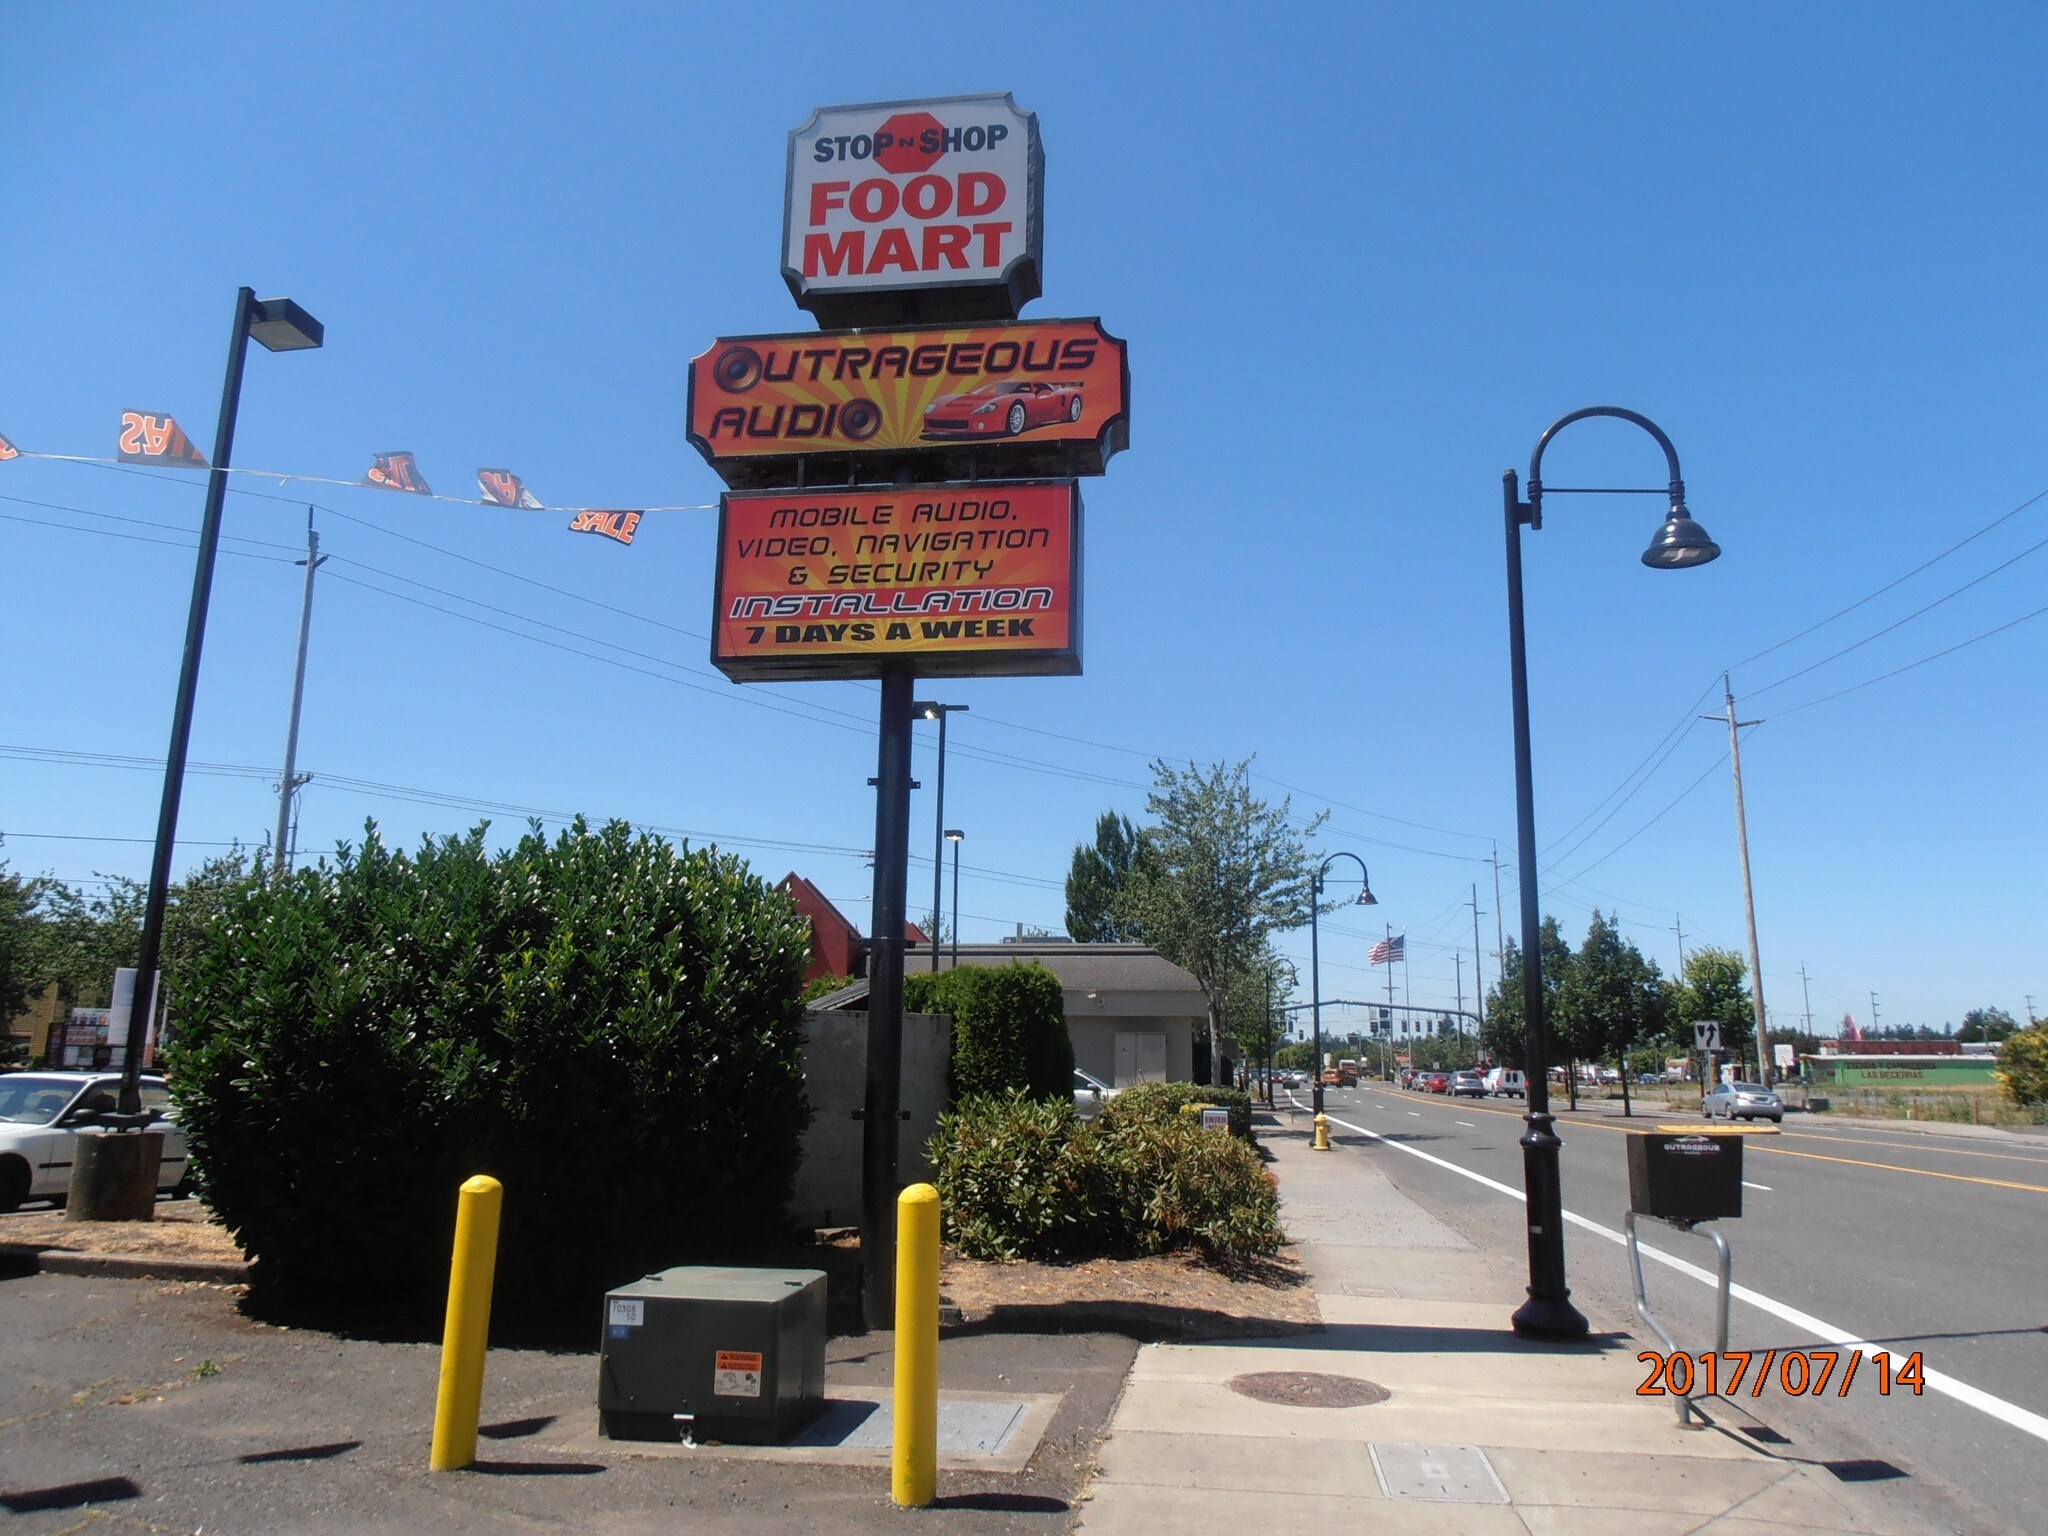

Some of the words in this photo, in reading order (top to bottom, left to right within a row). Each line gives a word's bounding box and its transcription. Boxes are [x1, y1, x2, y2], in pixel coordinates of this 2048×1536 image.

[813, 132, 894, 163] STOP
[919, 124, 1008, 154] SHOP
[809, 171, 1007, 227] FOOD
[802, 221, 1012, 278] MART
[714, 338, 1098, 393] OUTRAGEOUS
[709, 399, 883, 442] AUDIO
[570, 511, 641, 544] SALE
[769, 504, 894, 529] MOBILE
[856, 527, 1050, 555] NAVIGATION
[788, 565, 808, 586] &
[828, 559, 995, 585] SECURITY
[729, 586, 1054, 619] INSTALLATION
[745, 626, 767, 645] 7
[775, 622, 876, 645] DAYS
[884, 621, 913, 641] A
[920, 618, 1036, 640] WEEK
[1861, 1071, 1879, 1079] LAS
[1664, 1143, 1720, 1152] OUTRAGEOUS
[626, 1312, 637, 1321] 50
